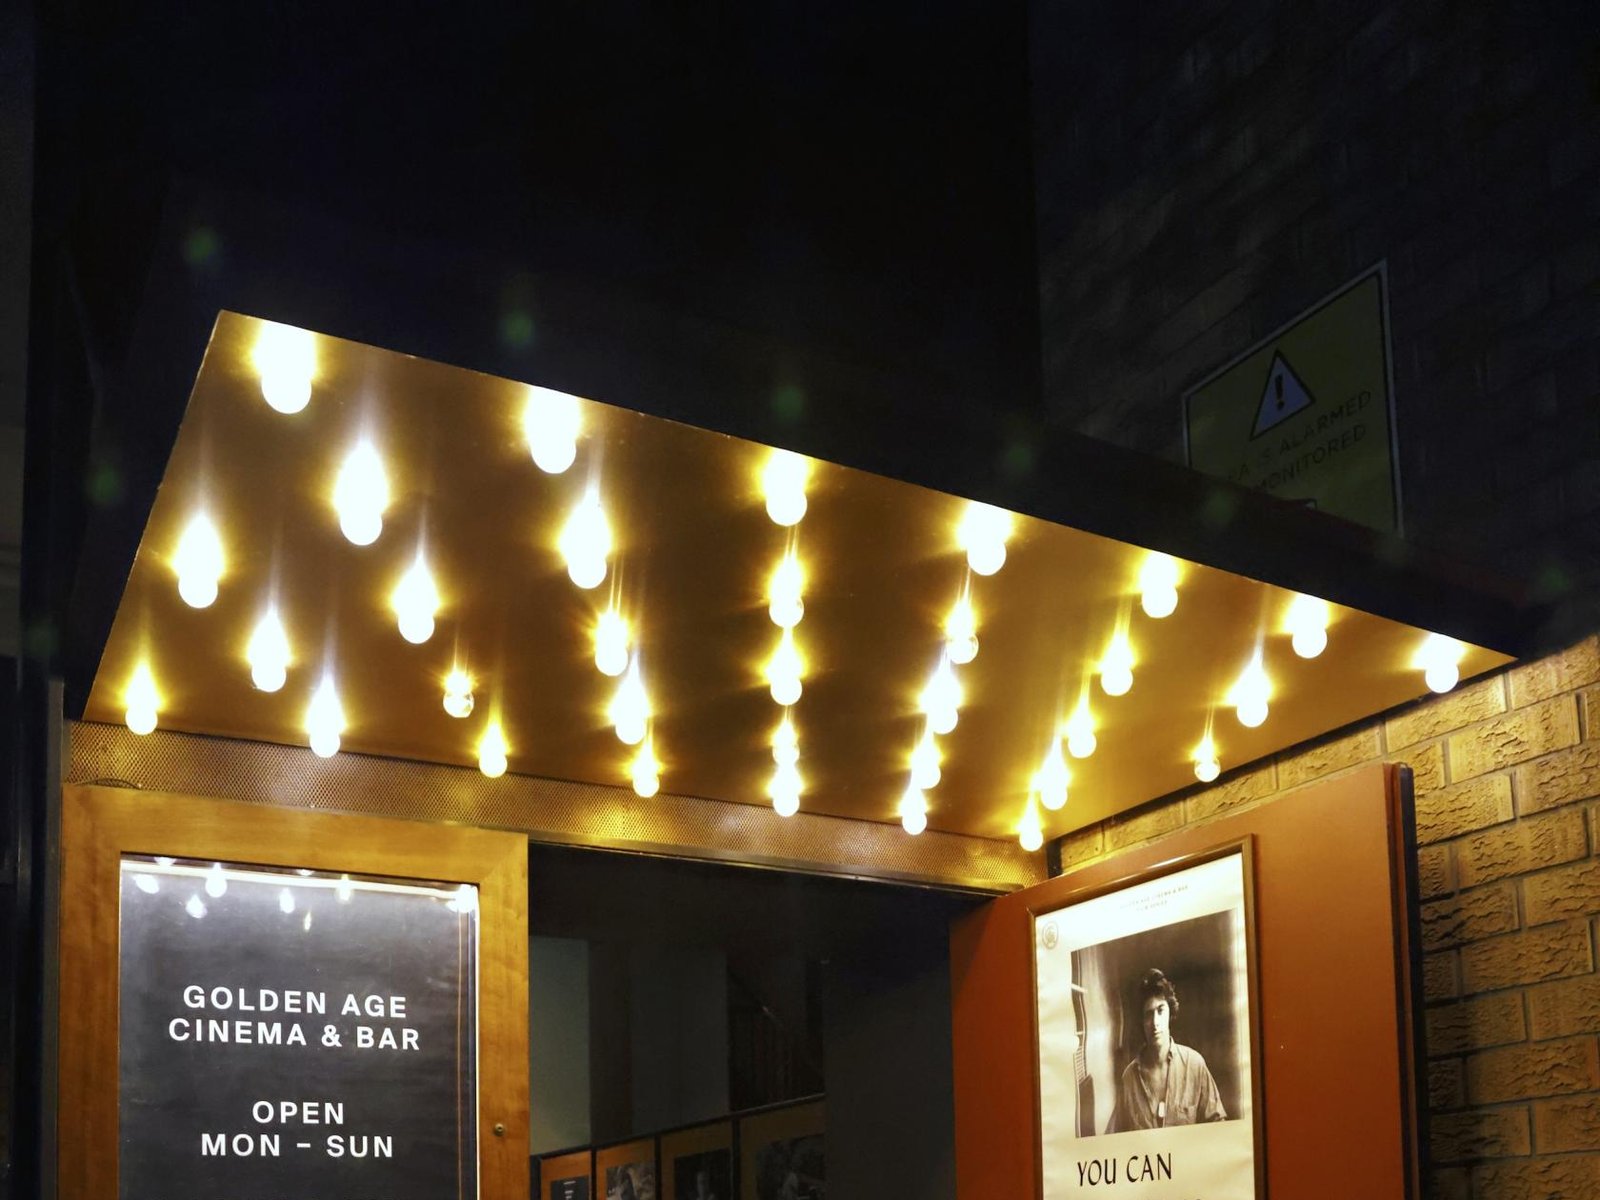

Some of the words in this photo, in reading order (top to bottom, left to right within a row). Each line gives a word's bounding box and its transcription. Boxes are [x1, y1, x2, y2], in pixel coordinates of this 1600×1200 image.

[1279, 391, 1371, 454] ALARMED
[183, 985, 326, 1015] GOLDEN
[341, 993, 406, 1018] AGE
[168, 1018, 307, 1046] CINEMA
[321, 1024, 342, 1048] &
[356, 1026, 420, 1050] BAR
[252, 1100, 344, 1125] OPEN
[201, 1133, 280, 1157] MON
[326, 1135, 393, 1158] SUN
[1077, 1157, 1117, 1187] YOU
[1126, 1152, 1173, 1183] CAN
